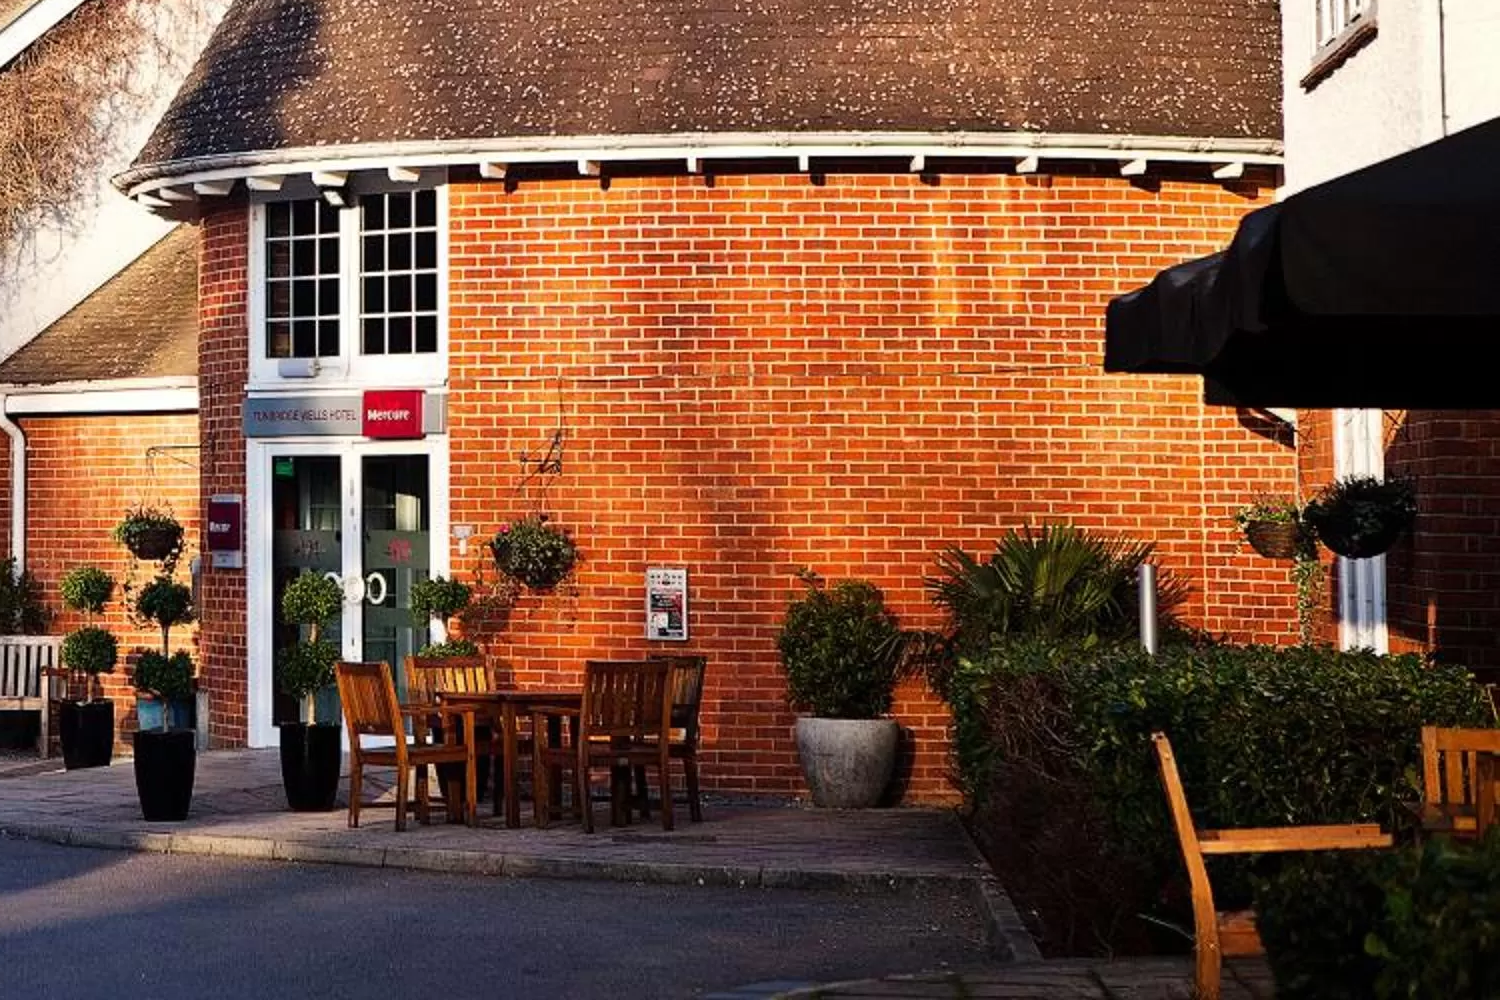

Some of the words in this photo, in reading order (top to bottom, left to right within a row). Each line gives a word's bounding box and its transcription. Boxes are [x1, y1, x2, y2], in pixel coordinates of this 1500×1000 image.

[301, 409, 327, 421] WELLS
[329, 408, 357, 421] HOTEL
[367, 409, 410, 421] Mercure
